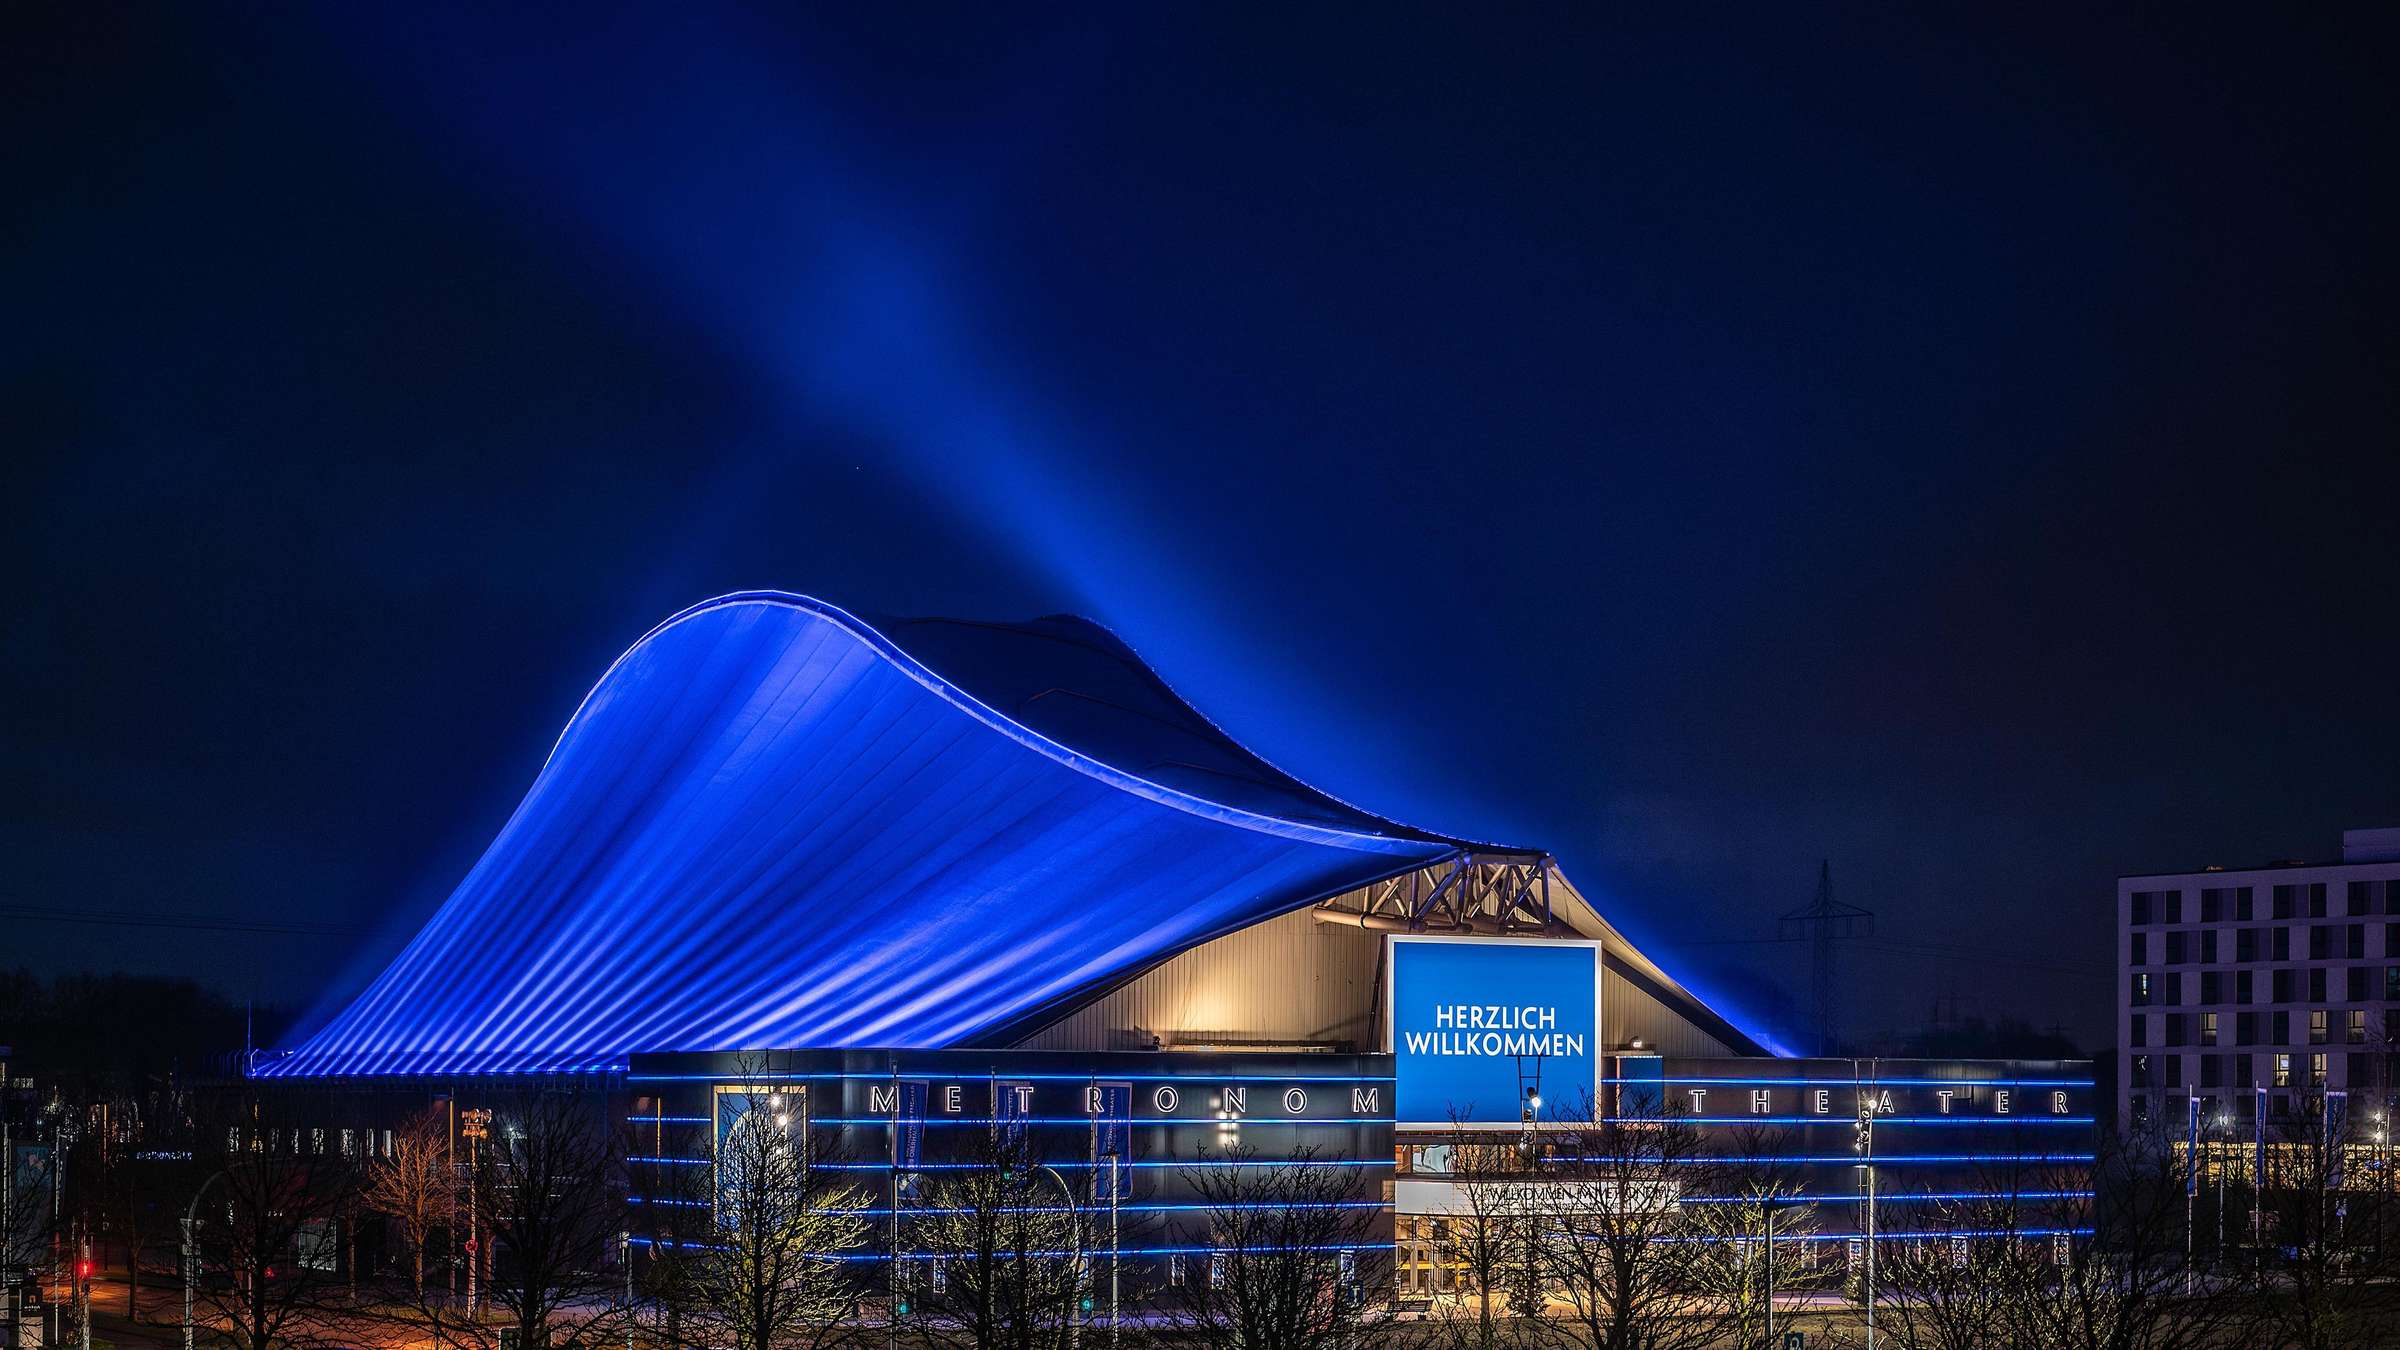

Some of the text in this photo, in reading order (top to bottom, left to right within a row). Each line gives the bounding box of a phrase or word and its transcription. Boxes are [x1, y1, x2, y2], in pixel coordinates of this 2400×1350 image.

[1436, 1005, 1555, 1030] HERZLICH
[1405, 1031, 1584, 1057] WILLKOMMEN
[870, 1085, 2069, 1114] METRONOM THEATER
